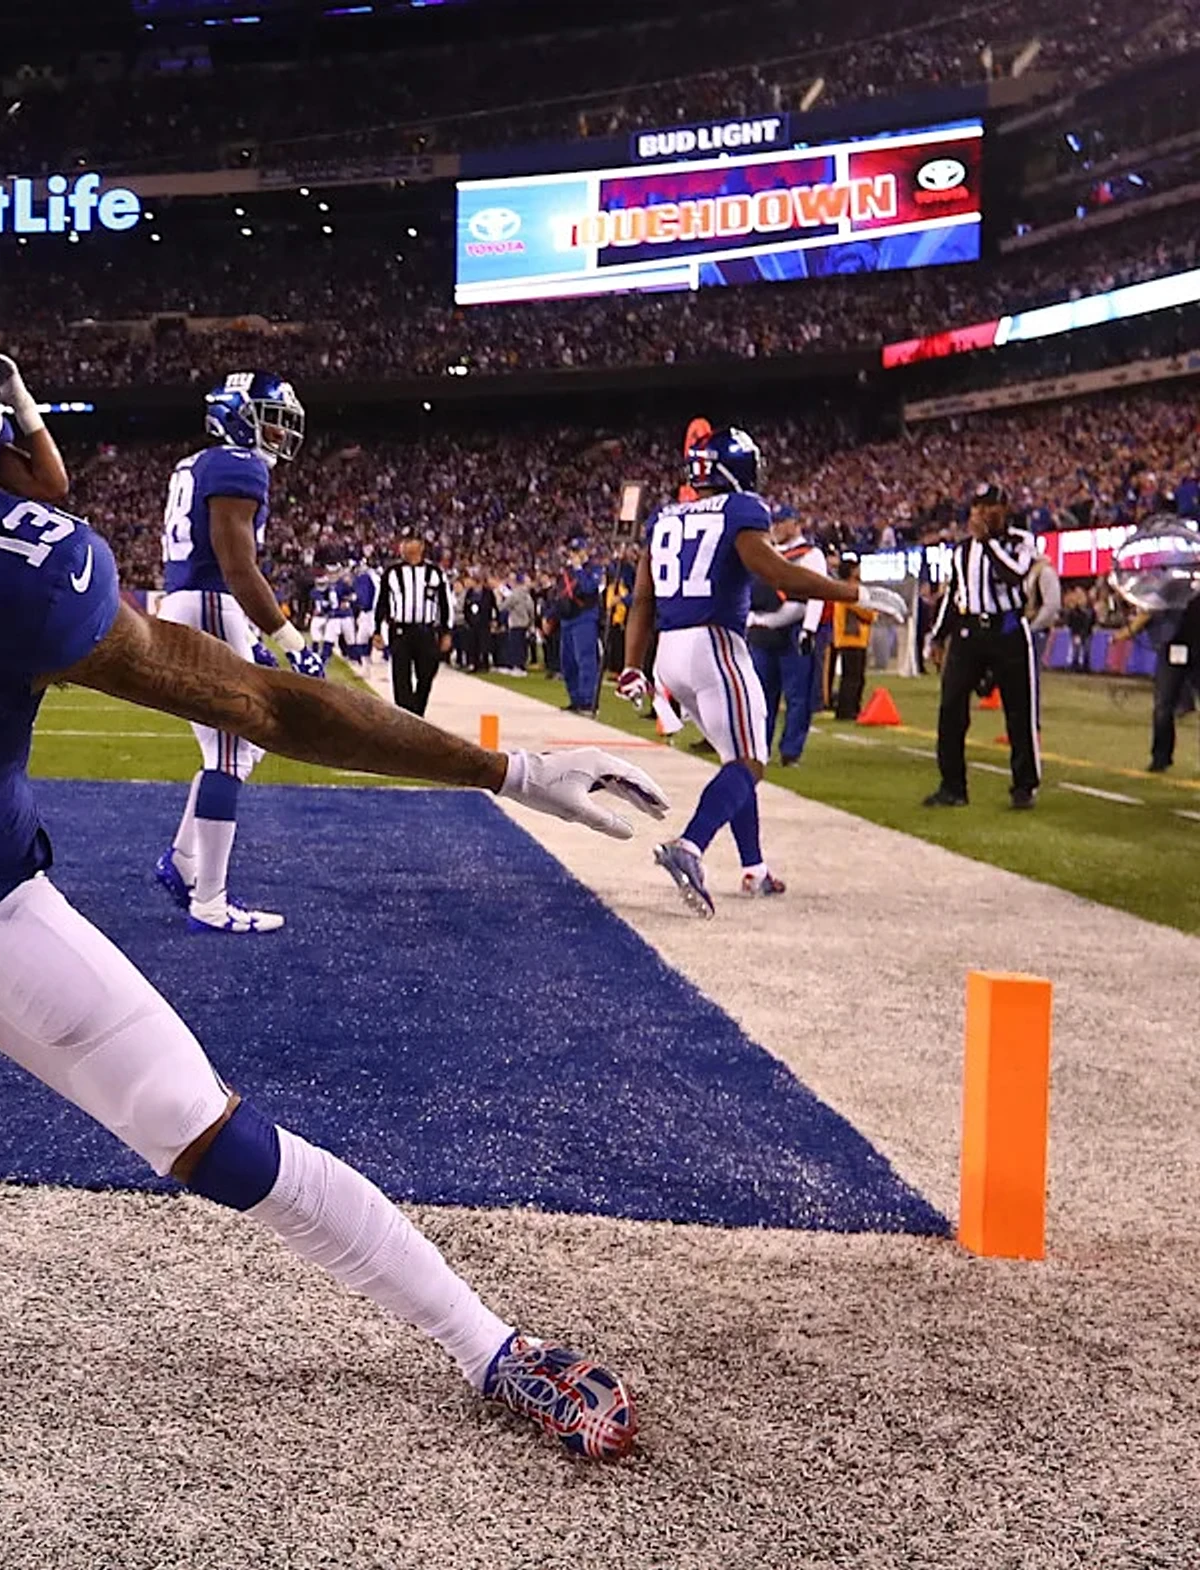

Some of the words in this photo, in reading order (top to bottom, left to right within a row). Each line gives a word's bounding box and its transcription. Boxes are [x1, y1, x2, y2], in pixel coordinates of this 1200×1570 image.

[638, 130, 697, 158] BUD
[697, 118, 781, 150] LIGHT
[465, 240, 526, 256] TOYOTA
[650, 513, 725, 598] 87
